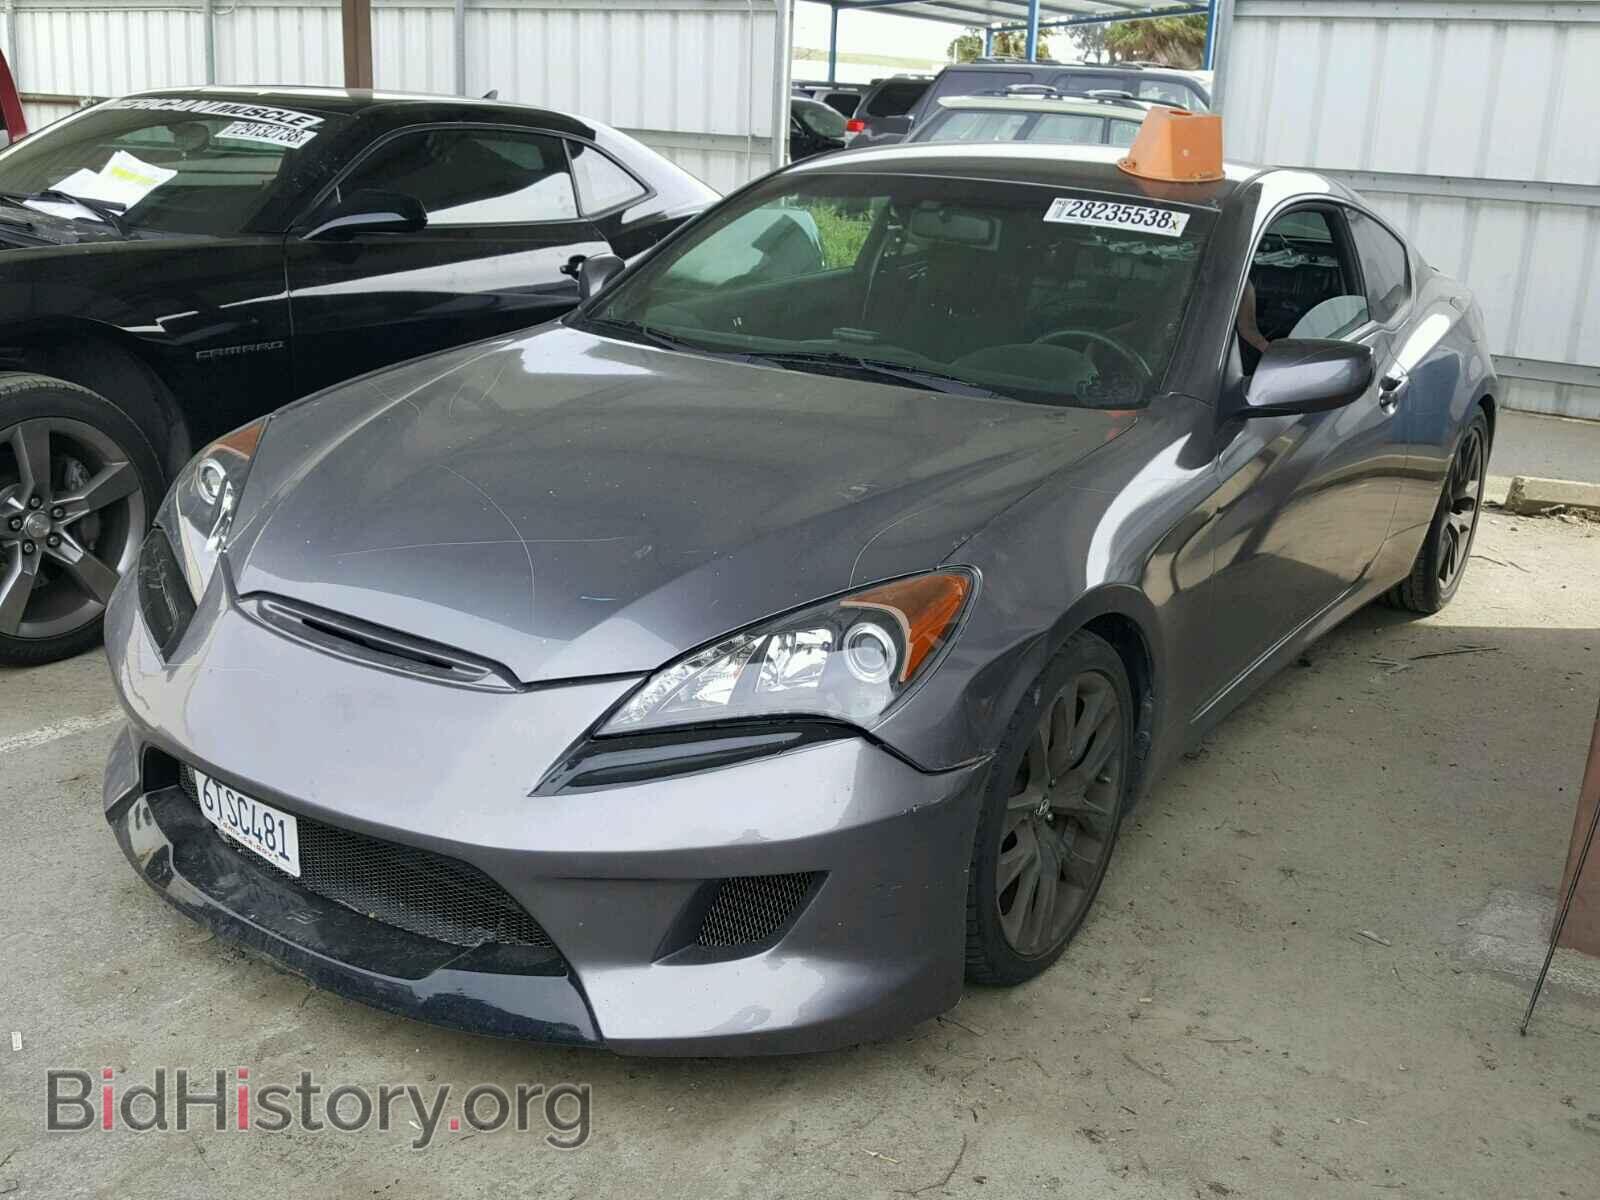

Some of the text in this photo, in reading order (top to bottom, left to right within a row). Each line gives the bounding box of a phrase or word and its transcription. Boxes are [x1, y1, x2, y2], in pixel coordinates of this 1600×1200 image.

[212, 103, 314, 126] MUSCLE
[196, 340, 284, 360] CAMARO
[203, 776, 290, 862] 6TSC481
